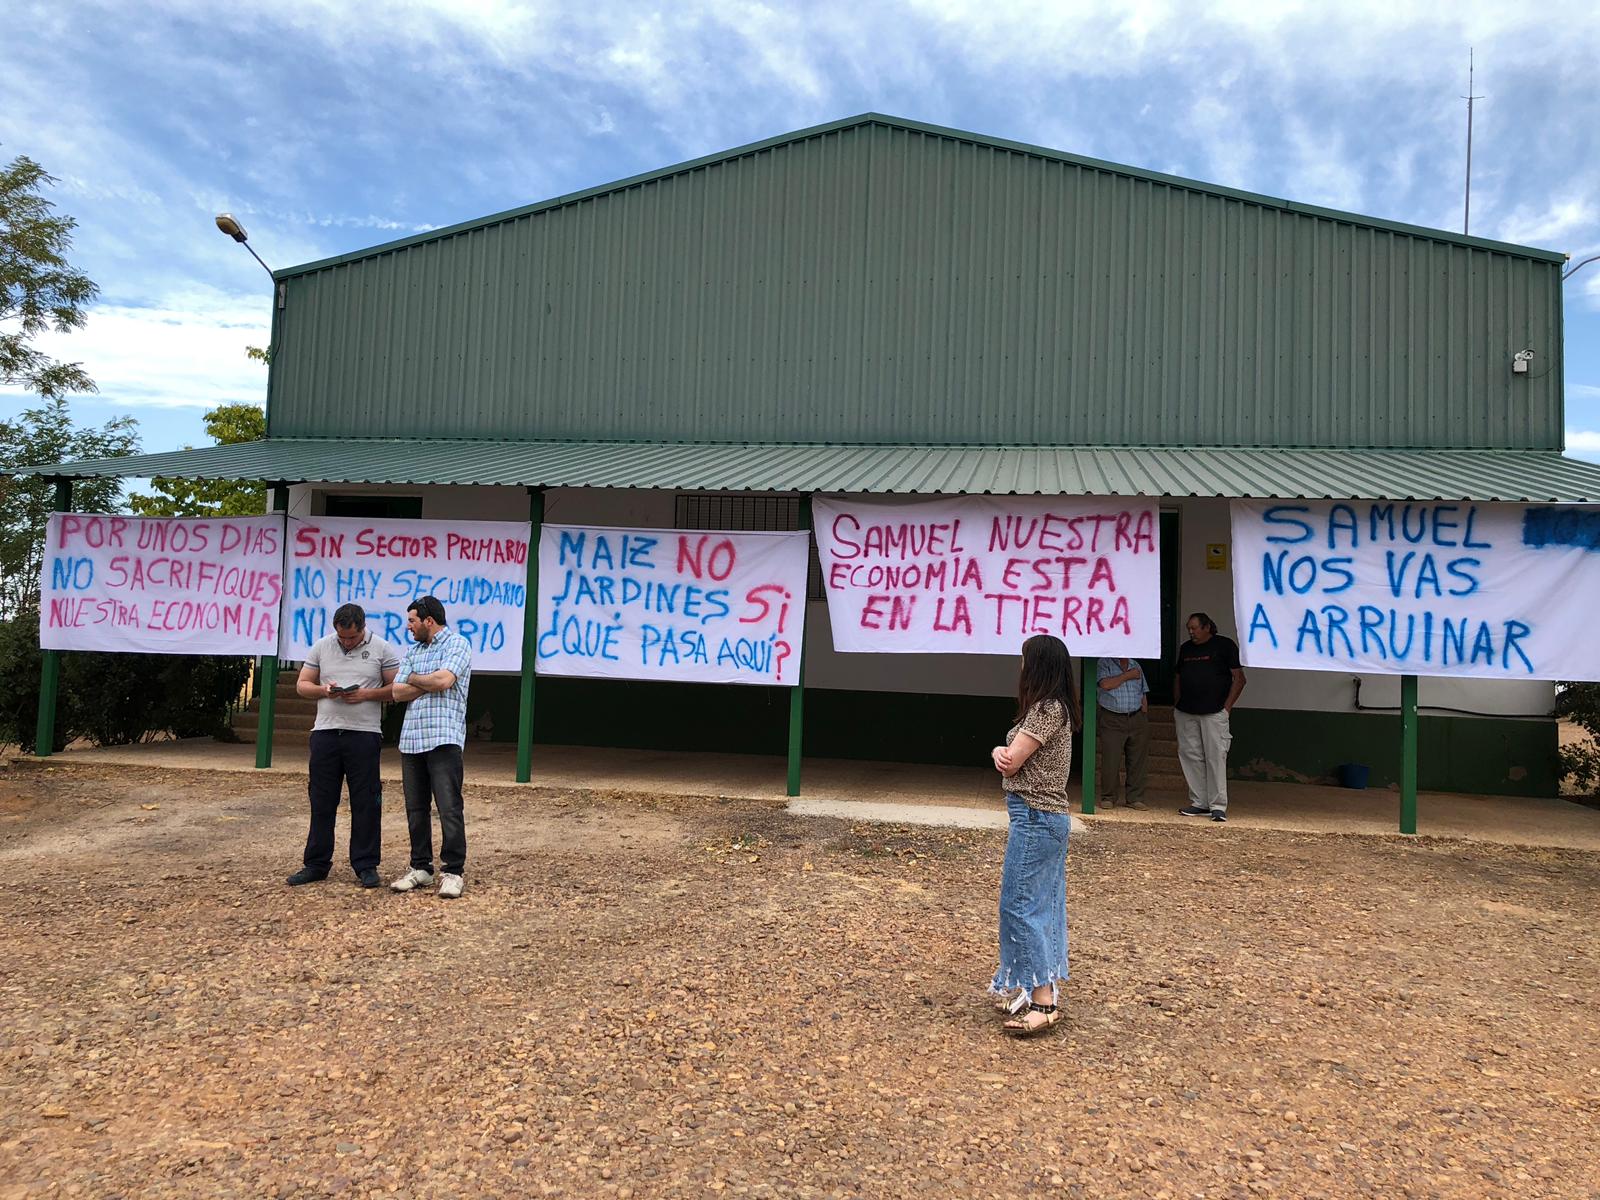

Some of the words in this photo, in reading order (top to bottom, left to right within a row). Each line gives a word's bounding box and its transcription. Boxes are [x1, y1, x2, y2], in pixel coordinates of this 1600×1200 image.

[59, 515, 128, 549] POR
[137, 519, 210, 552] UNOS
[221, 524, 277, 555] DIAS
[294, 527, 344, 558] SIN
[356, 528, 437, 558] SECTOR
[447, 532, 528, 564] PRIMARIO
[830, 513, 963, 560] SAMUEL
[988, 510, 1155, 554] NUESTRA
[1263, 503, 1491, 549] SAMUEL
[559, 531, 658, 569] MAIZ
[677, 535, 737, 581] NO
[829, 557, 982, 591] ECONOMIA
[1003, 556, 1116, 592] ESTA
[1263, 550, 1354, 595] NOS
[1387, 550, 1481, 598] VAS
[52, 557, 94, 590] NO
[106, 556, 282, 607] SACRIFIQUES
[293, 565, 325, 599] NO
[336, 568, 381, 603] HAY
[552, 570, 730, 624] JARDINES
[49, 598, 139, 628] NUESTRA
[147, 600, 274, 641] ECONOMIA
[293, 607, 326, 647] NI
[861, 595, 916, 630] EN
[933, 595, 972, 635] LA
[984, 593, 1131, 636] TIERRA
[641, 624, 707, 666] PASA
[1249, 603, 1277, 649] A
[1296, 604, 1534, 674] ARRUINAR
